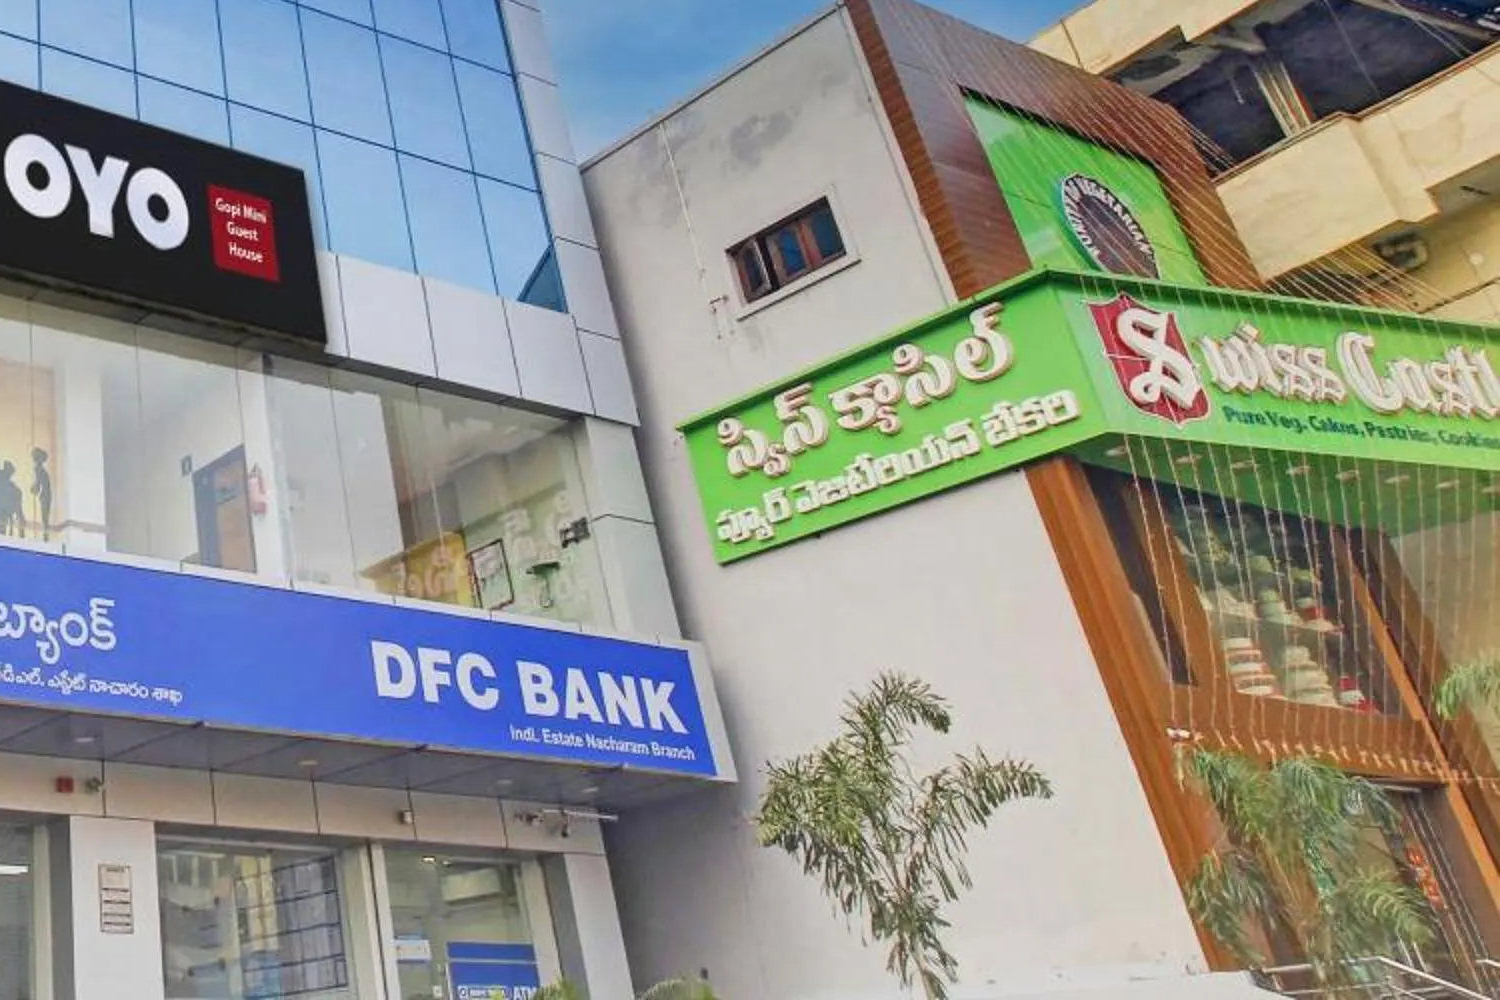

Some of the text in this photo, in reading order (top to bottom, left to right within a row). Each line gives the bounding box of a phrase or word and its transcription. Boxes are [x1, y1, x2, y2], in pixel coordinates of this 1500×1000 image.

[3, 133, 190, 250] OYO
[215, 197, 267, 224] Gopi Mini
[226, 221, 259, 242] Guest
[228, 241, 263, 264] House
[370, 640, 689, 735] DFC BANK
[541, 728, 584, 748] Estate
[586, 732, 650, 756] Nacharam
[651, 741, 696, 761] Branch
